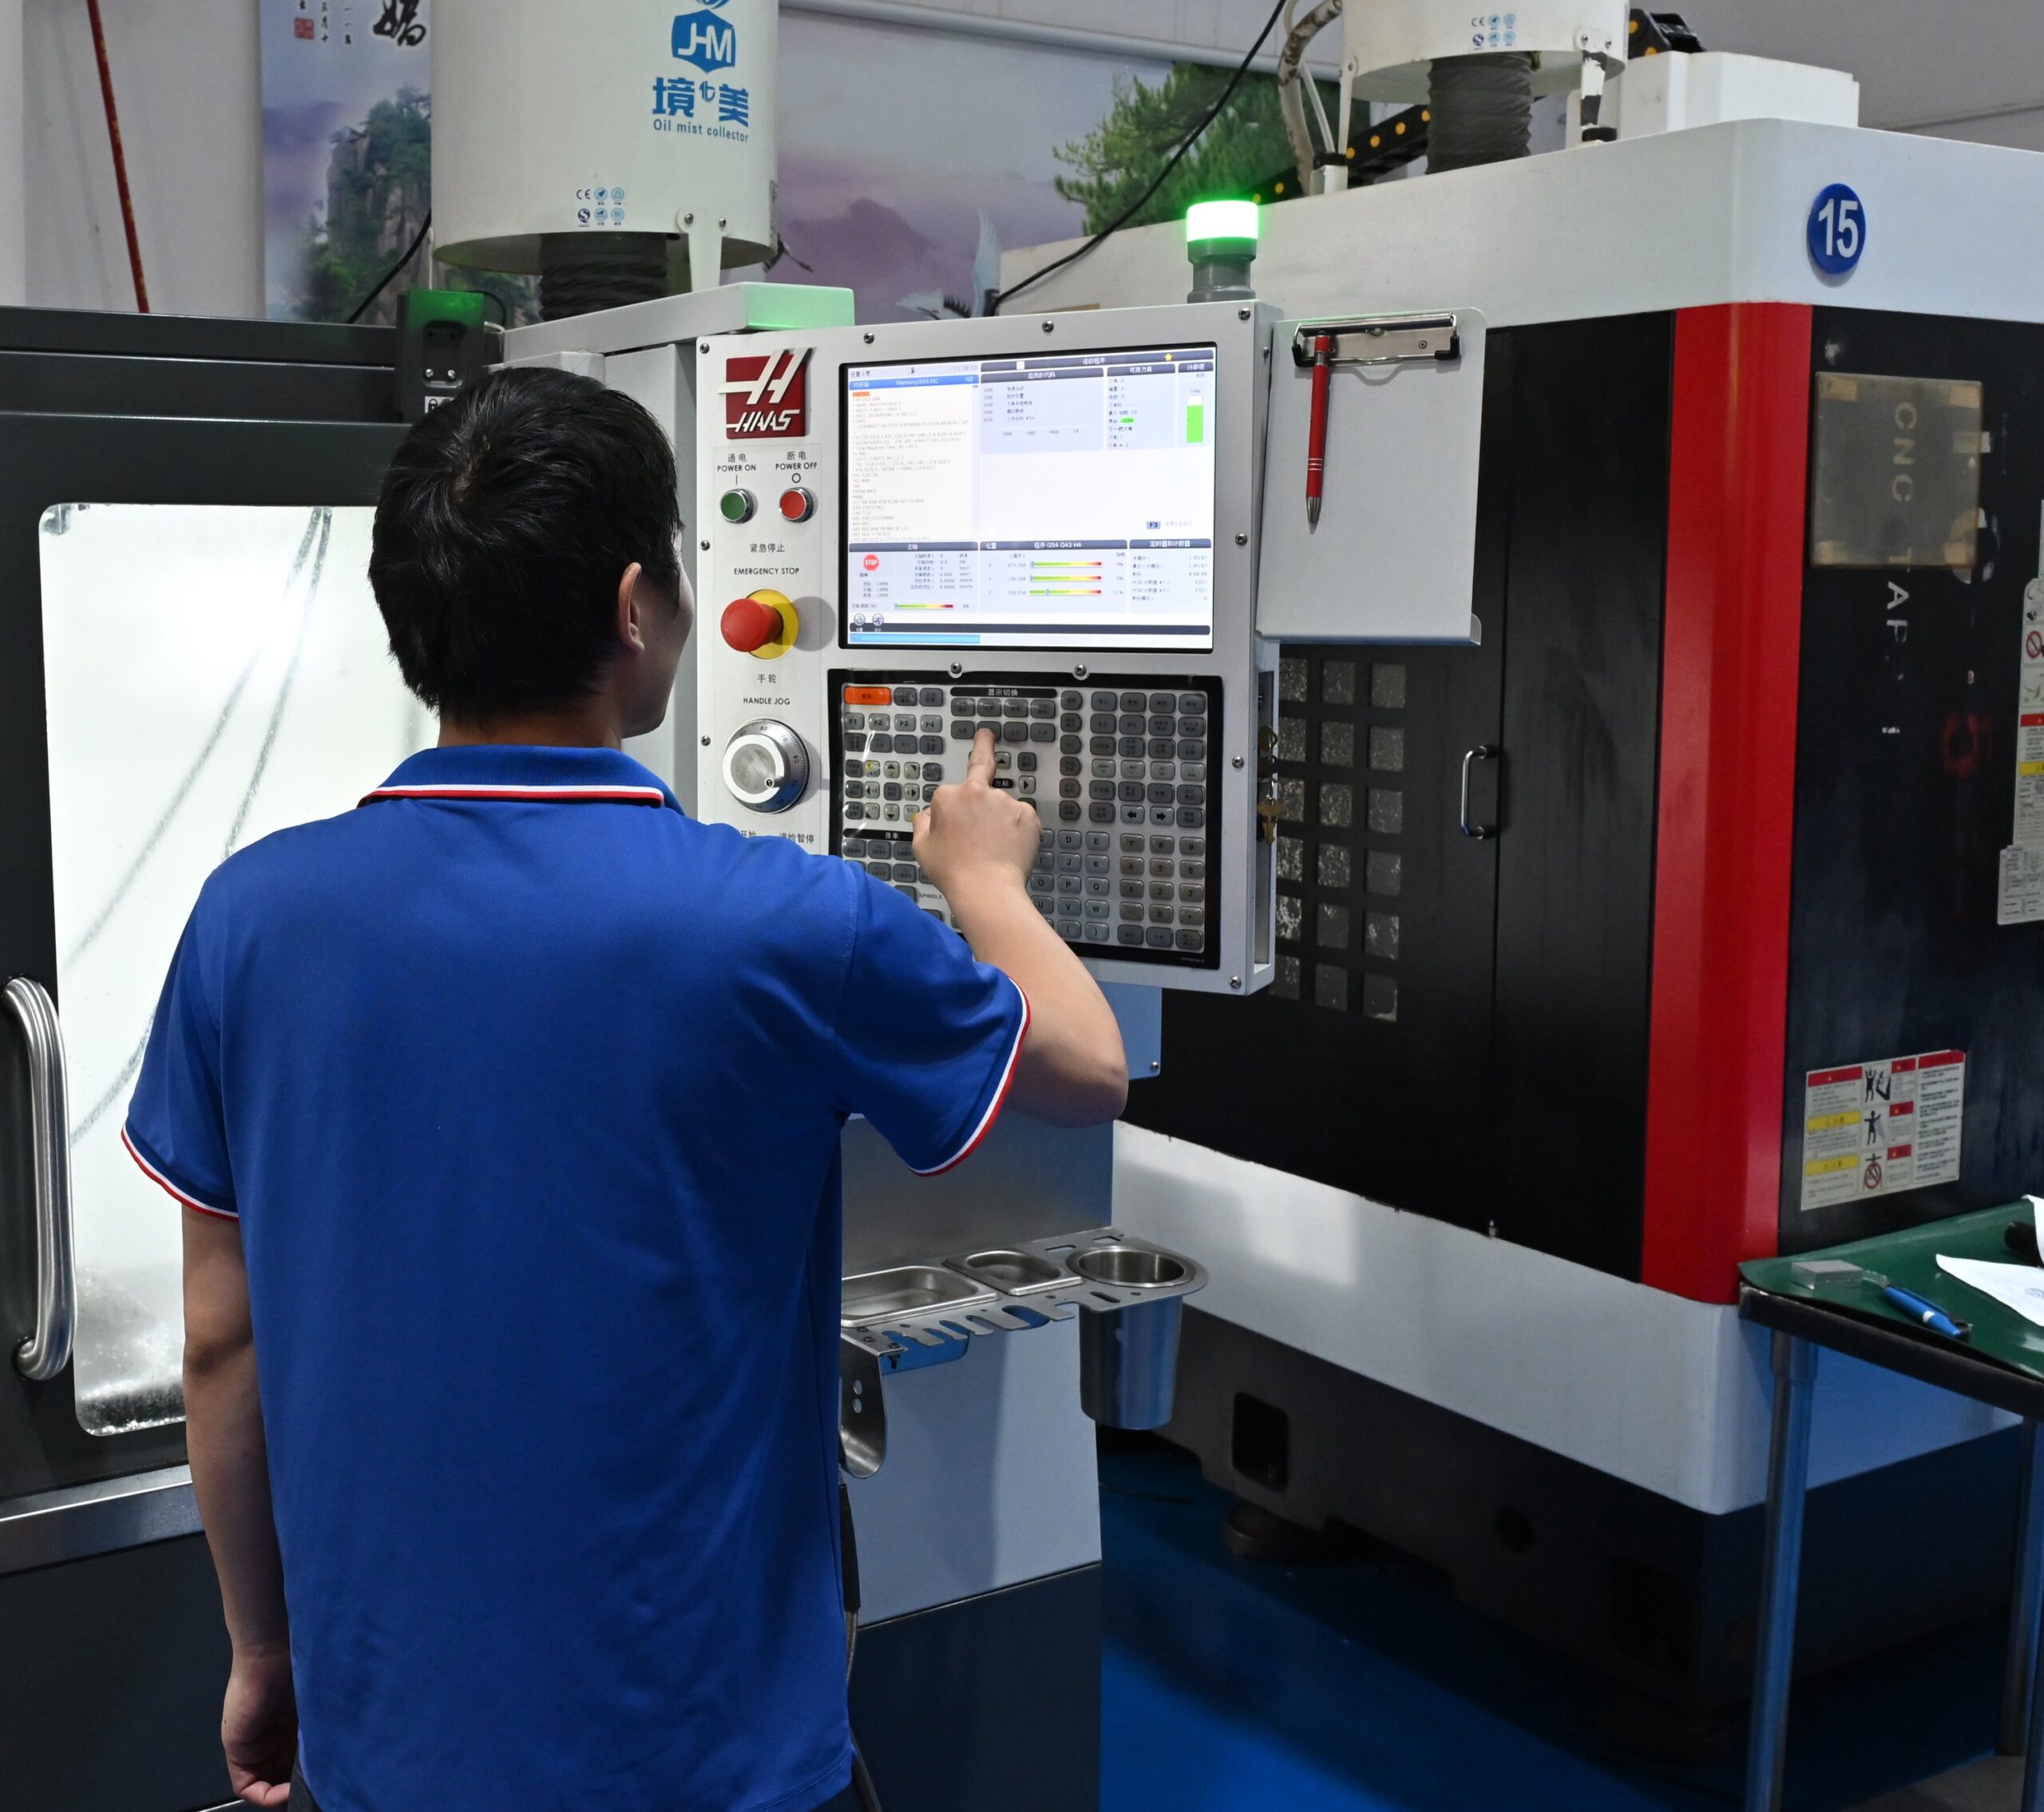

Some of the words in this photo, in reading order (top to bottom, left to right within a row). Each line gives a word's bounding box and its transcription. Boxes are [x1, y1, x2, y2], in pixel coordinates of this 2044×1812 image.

[653, 119, 671, 131] Oil
[677, 121, 702, 135] mist
[707, 126, 749, 142] collector
[1818, 198, 1859, 258] 15
[726, 409, 801, 433] HAAS
[727, 453, 747, 463] 通电
[786, 450, 806, 461] 断电
[1891, 402, 1917, 502] CNC
[749, 543, 786, 553] 紧急停止
[757, 673, 777, 684] 手轮
